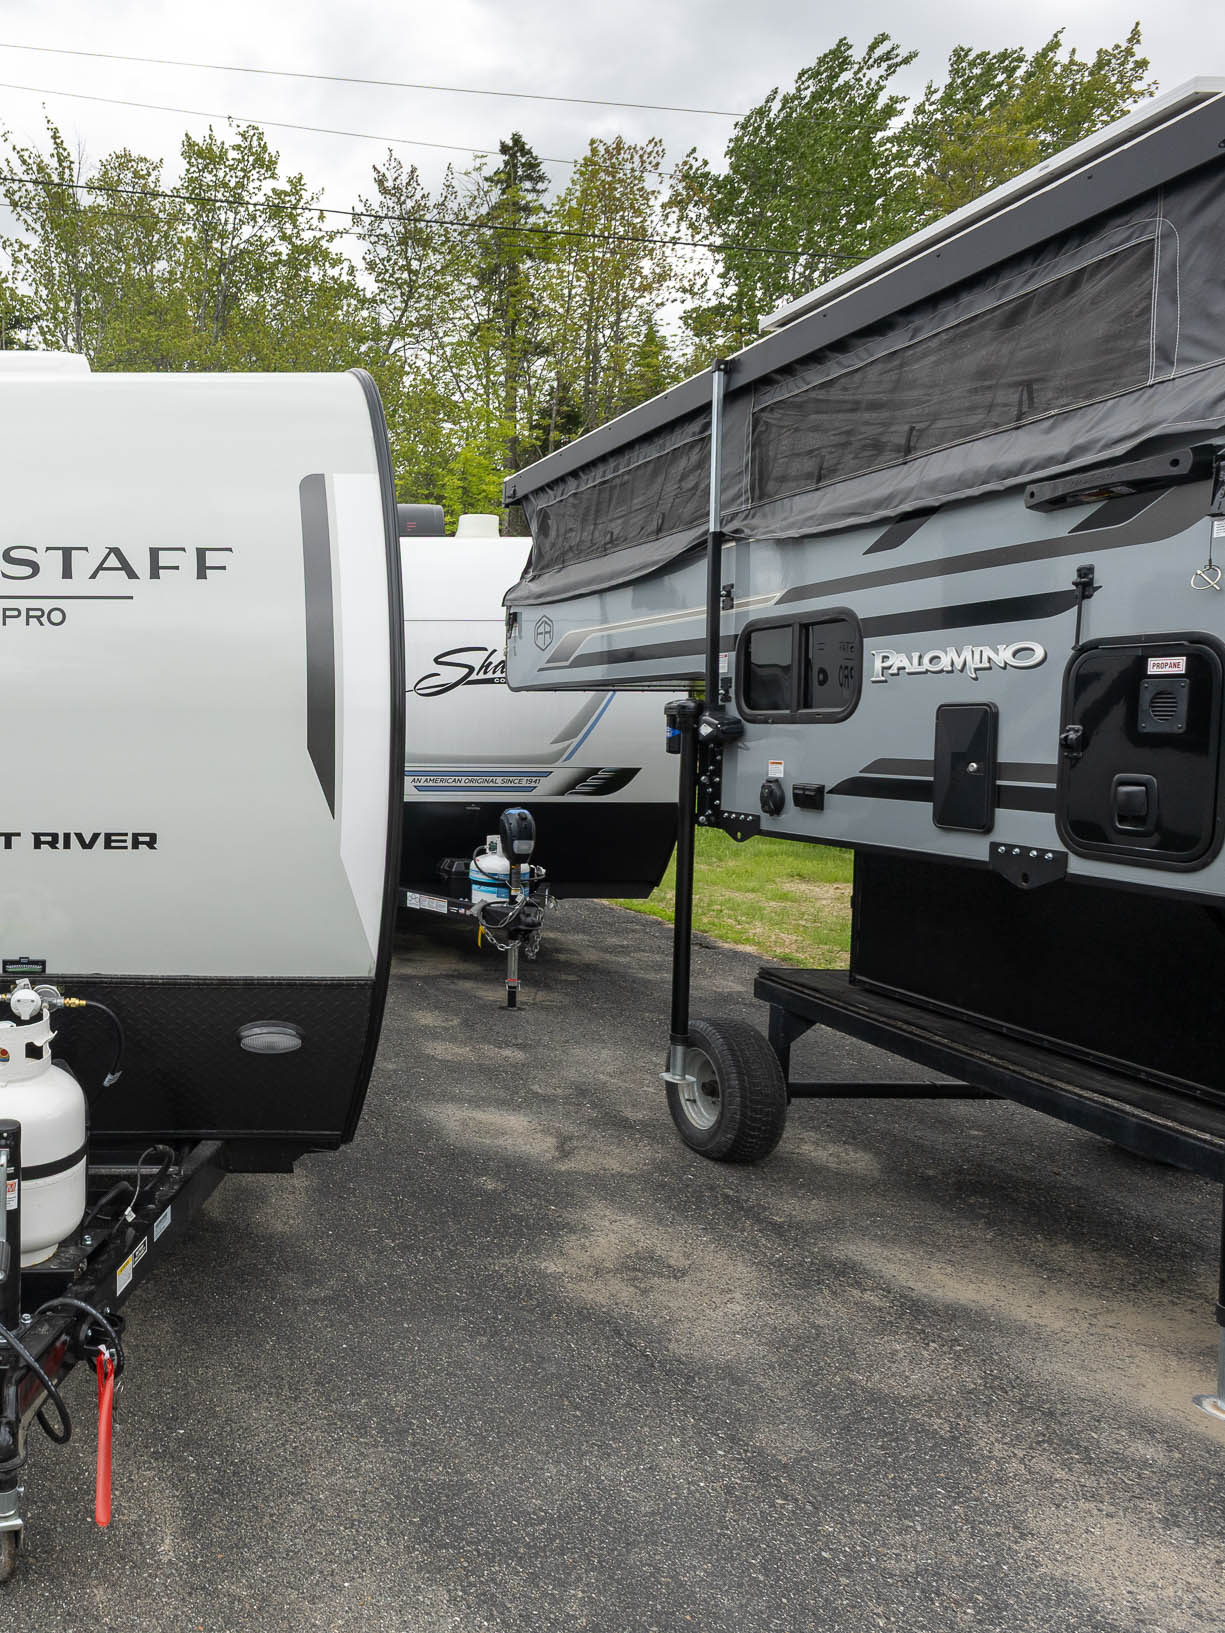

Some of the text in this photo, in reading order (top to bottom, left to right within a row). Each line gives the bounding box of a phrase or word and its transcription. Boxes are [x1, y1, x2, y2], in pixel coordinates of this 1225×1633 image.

[870, 641, 1048, 683] PALOMINO
[1152, 661, 1181, 670] PROPANE
[463, 777, 499, 785] ORIGINAL
[501, 777, 524, 785] SINCE
[32, 832, 157, 850] RIVER
